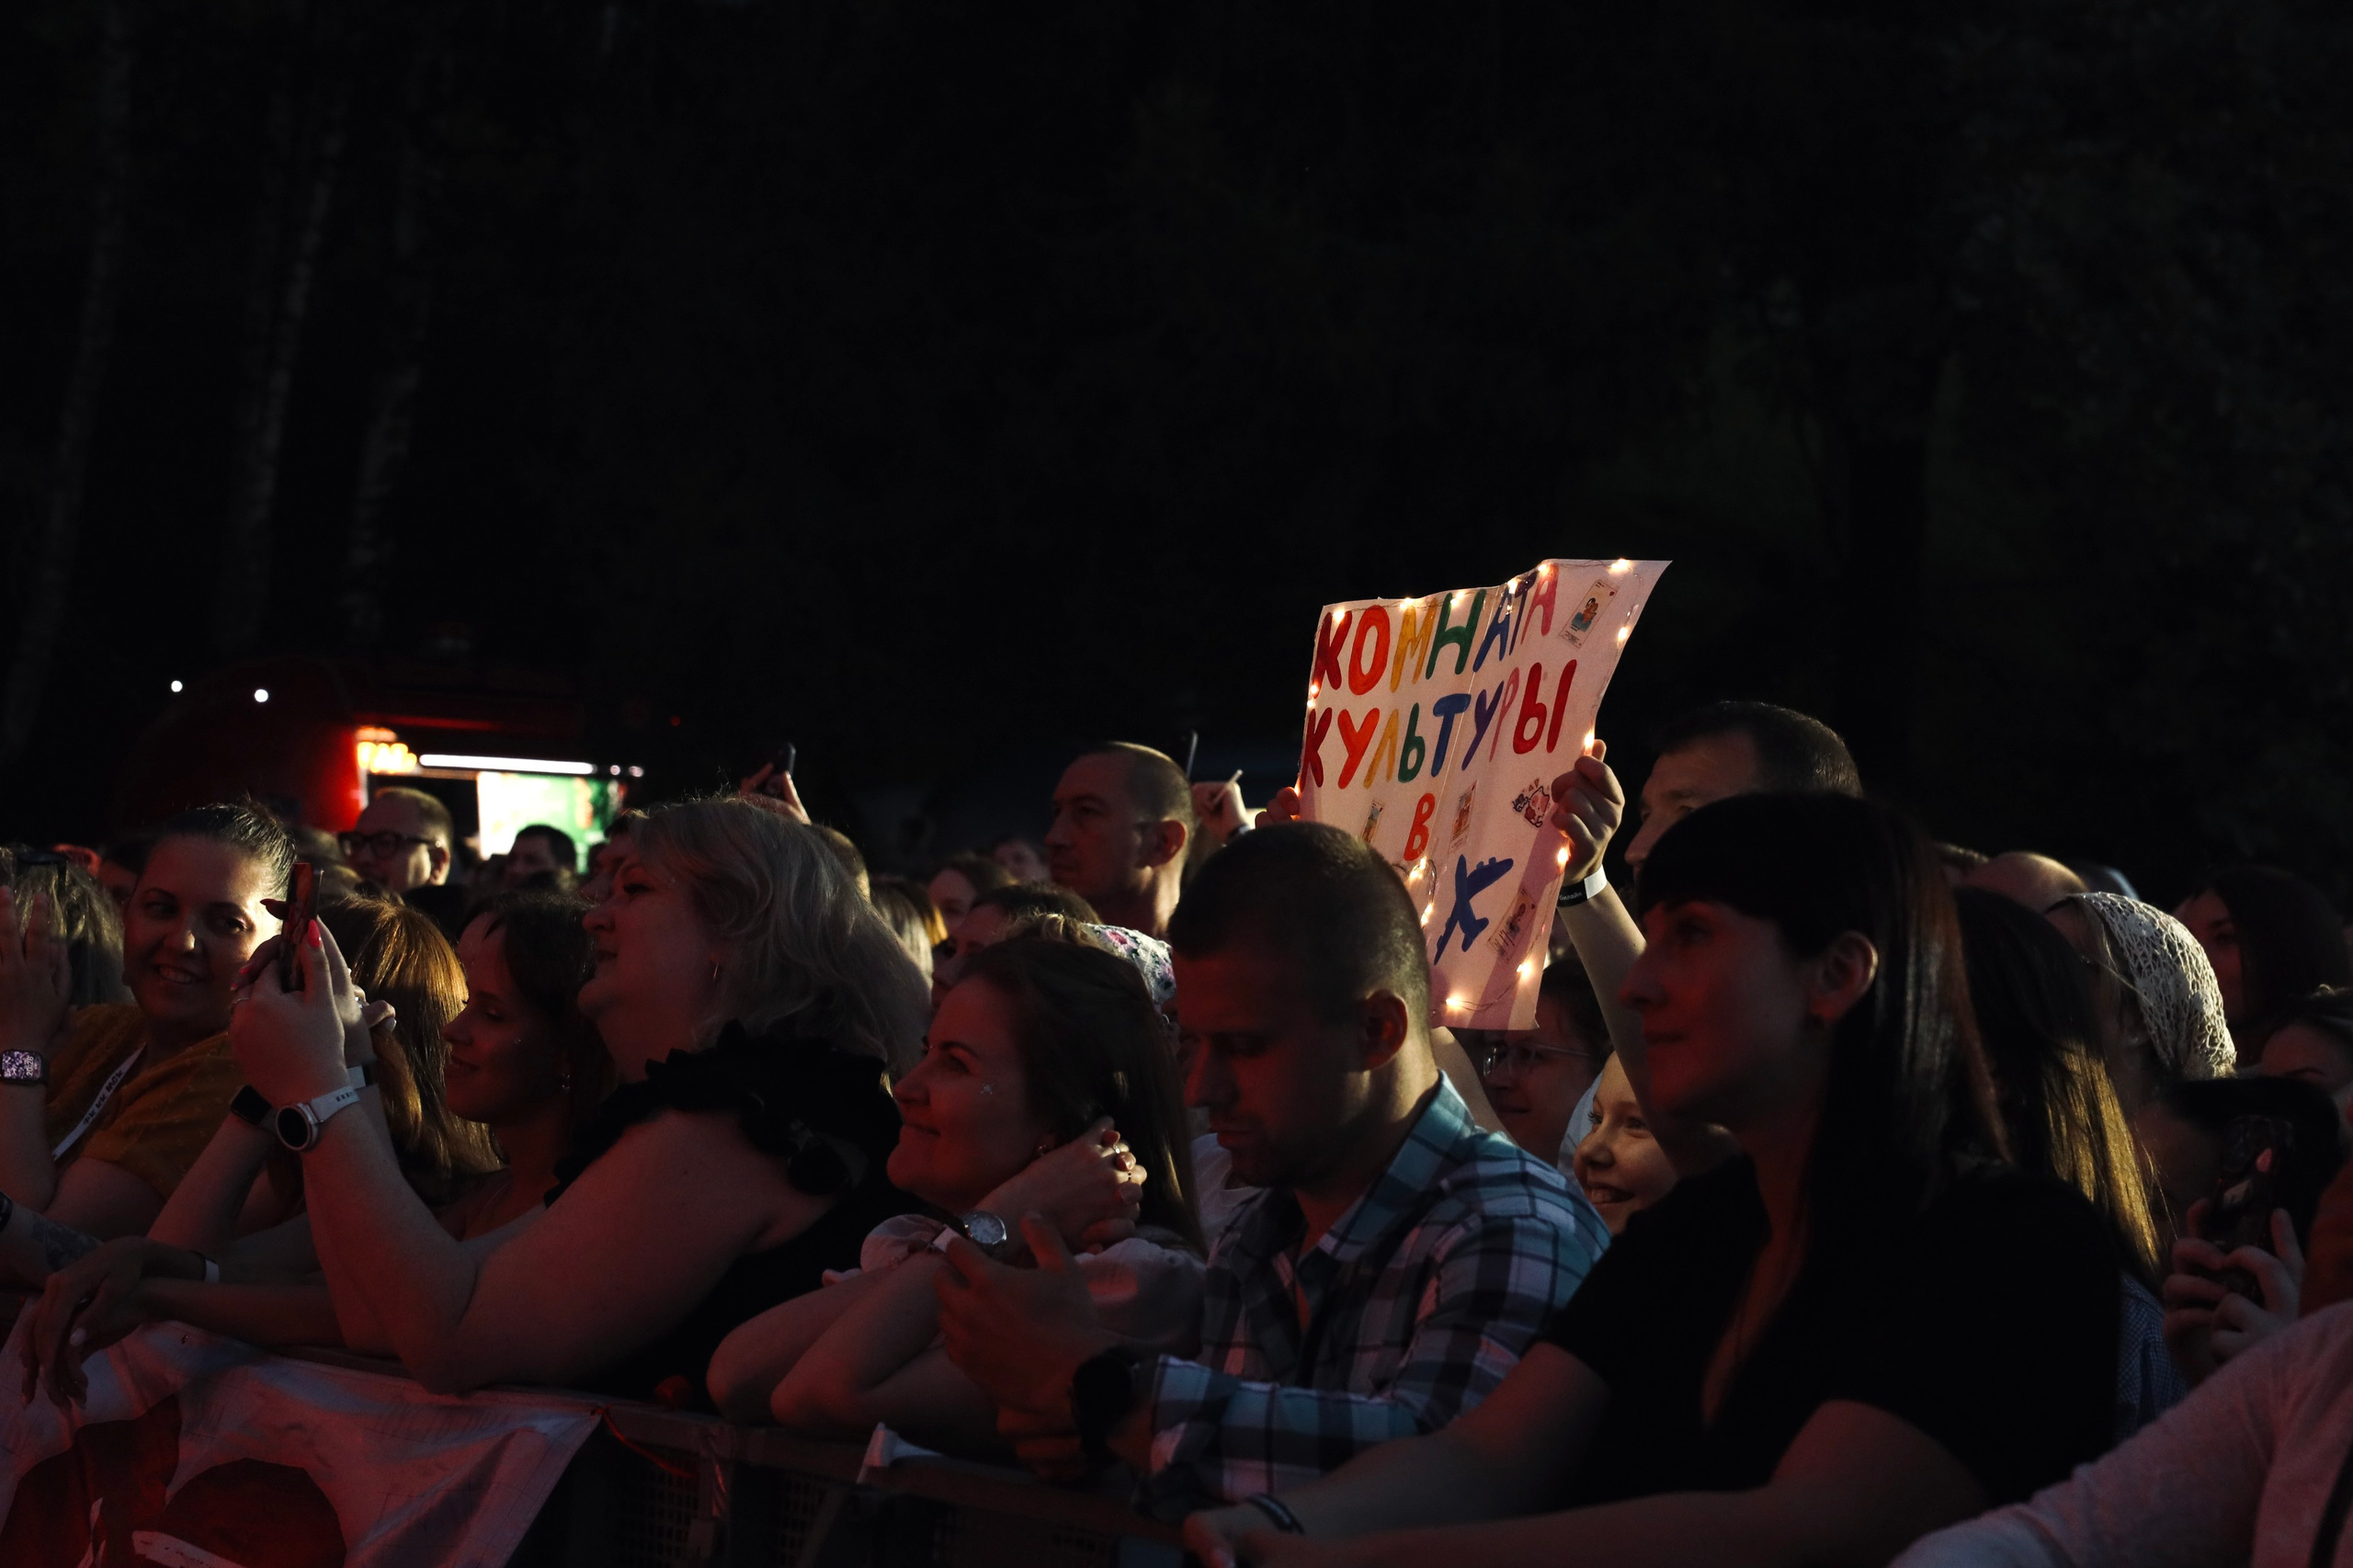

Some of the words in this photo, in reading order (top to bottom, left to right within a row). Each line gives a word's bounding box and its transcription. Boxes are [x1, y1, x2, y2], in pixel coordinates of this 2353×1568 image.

[1312, 562, 1559, 698] КОМНАТА
[1300, 659, 1578, 792] КУЛЬТУРЫ
[1404, 792, 1436, 861] В
